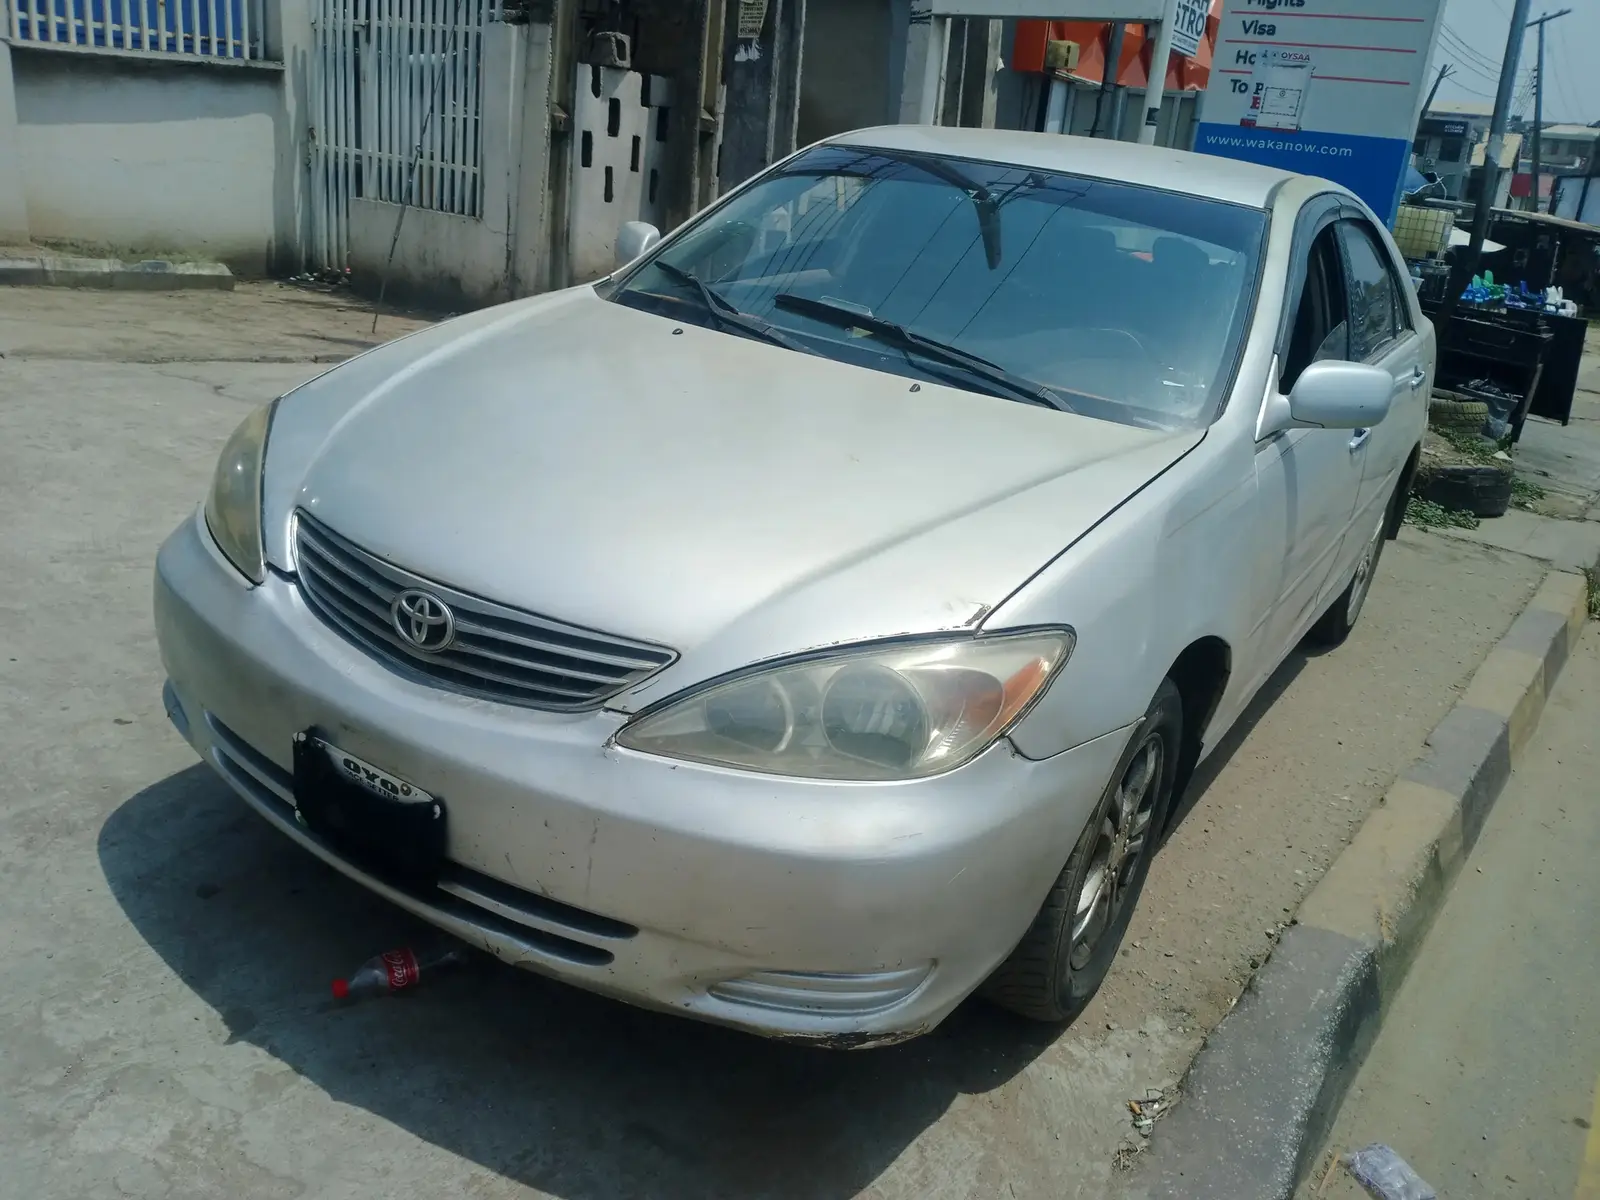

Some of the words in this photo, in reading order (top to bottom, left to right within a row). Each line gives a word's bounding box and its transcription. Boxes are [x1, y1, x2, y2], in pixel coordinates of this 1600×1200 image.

[1241, 19, 1277, 36] Visa
[1230, 78, 1249, 95] To
[1205, 134, 1354, 157] www.wakanow.com
[343, 757, 399, 795] OYO
